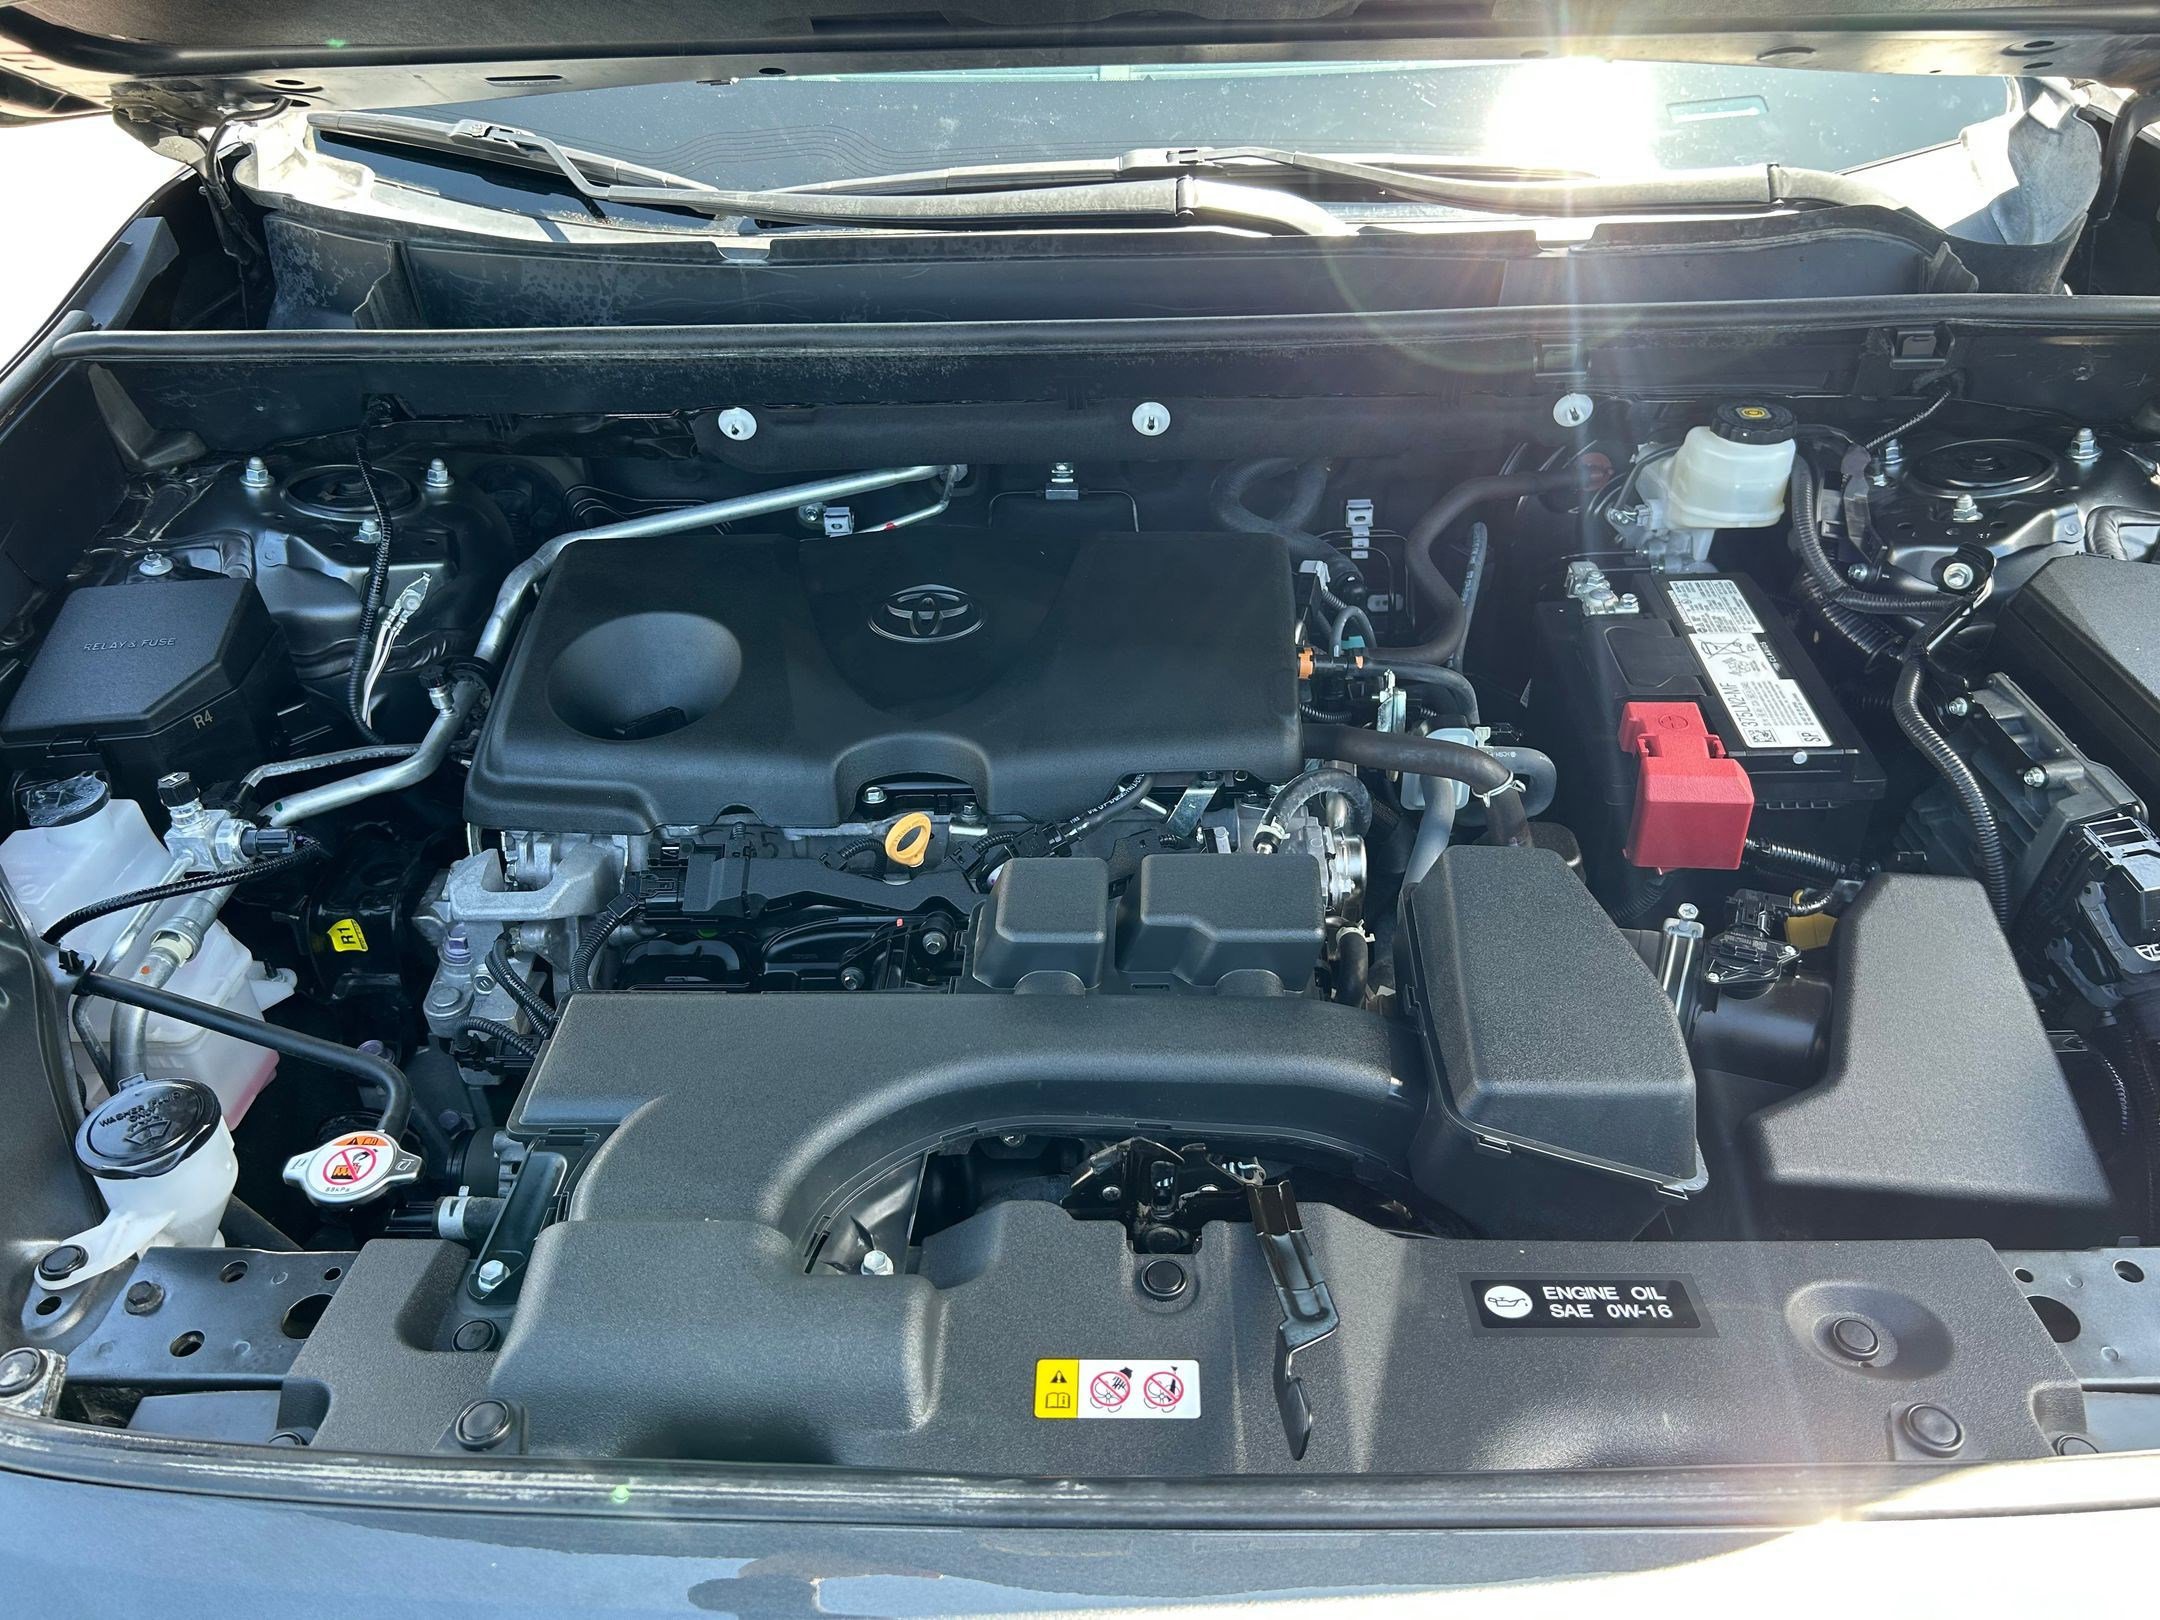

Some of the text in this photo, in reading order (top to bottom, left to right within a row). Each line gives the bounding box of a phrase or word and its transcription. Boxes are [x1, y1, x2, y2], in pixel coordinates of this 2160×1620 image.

[83, 640, 127, 651] RELAY
[141, 637, 177, 648] FUSE
[192, 709, 214, 730] R4
[1801, 732, 1821, 743] SP
[160, 772, 187, 786] H
[336, 927, 356, 945] R1
[98, 1104, 146, 1128] WASHER
[128, 1107, 160, 1123] ONLY
[1542, 1286, 1667, 1301] ENGINE OIL
[1549, 1304, 1673, 1319] SAE 0W-16
